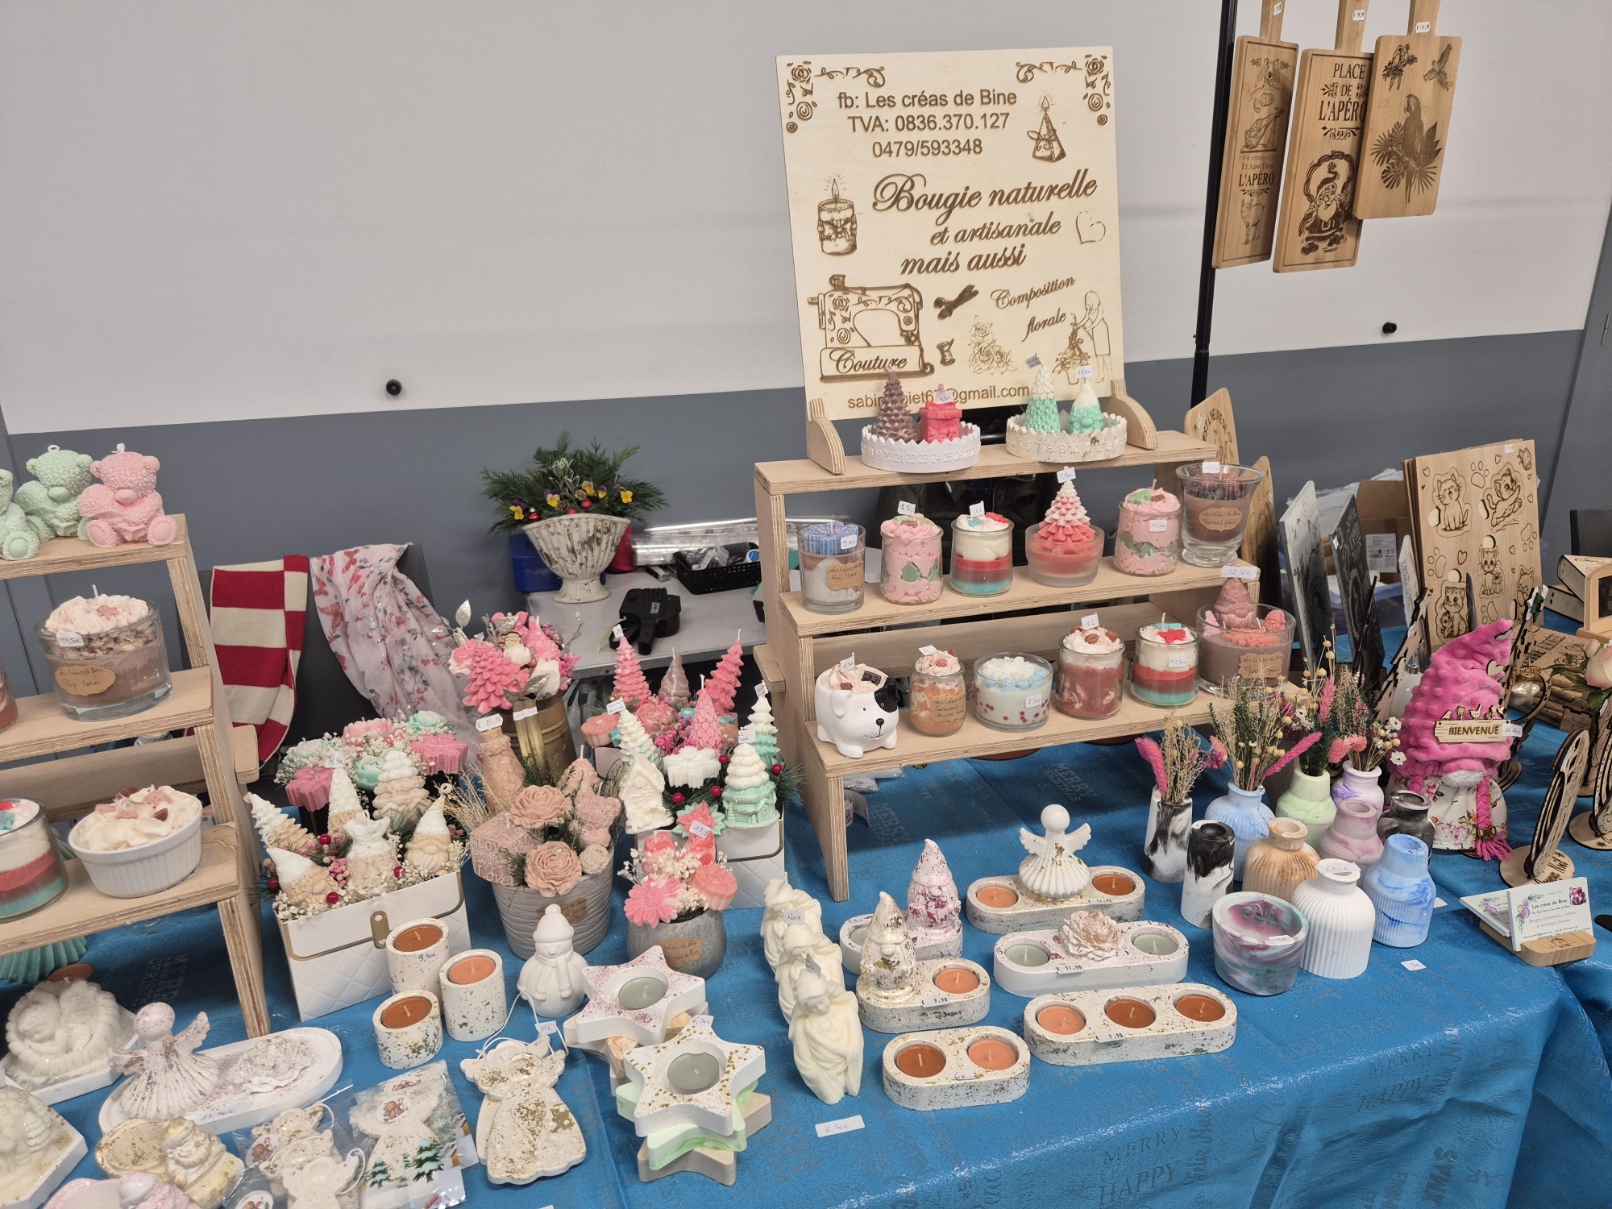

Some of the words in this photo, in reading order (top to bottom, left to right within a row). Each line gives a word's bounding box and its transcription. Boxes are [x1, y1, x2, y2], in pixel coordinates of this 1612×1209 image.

[1333, 62, 1367, 80] PLACE
[837, 92, 860, 110] fb:
[865, 91, 896, 109] Les
[901, 90, 949, 108] créas
[953, 89, 975, 106] de
[980, 89, 1017, 105] Bine
[1340, 84, 1354, 97] DE
[1318, 97, 1368, 122] L'APÉRO
[848, 116, 889, 134] TVA:
[894, 112, 1010, 133] 0836.370.127
[872, 138, 984, 158] 0479/593348
[1239, 169, 1275, 187] L'APÉRO
[872, 173, 982, 227] Bougie
[988, 168, 1099, 207] naturelle
[929, 227, 951, 247] et
[954, 211, 1063, 244] artisanale
[899, 250, 961, 276] mais
[966, 243, 1028, 273] aussi
[989, 274, 1077, 310] Composition
[1020, 307, 1068, 343] florale
[829, 348, 909, 374] Couture
[1448, 725, 1500, 736] BIENVENUE
[1103, 1124, 1184, 1166] MERRY
[1097, 1159, 1182, 1207] HAPPY
